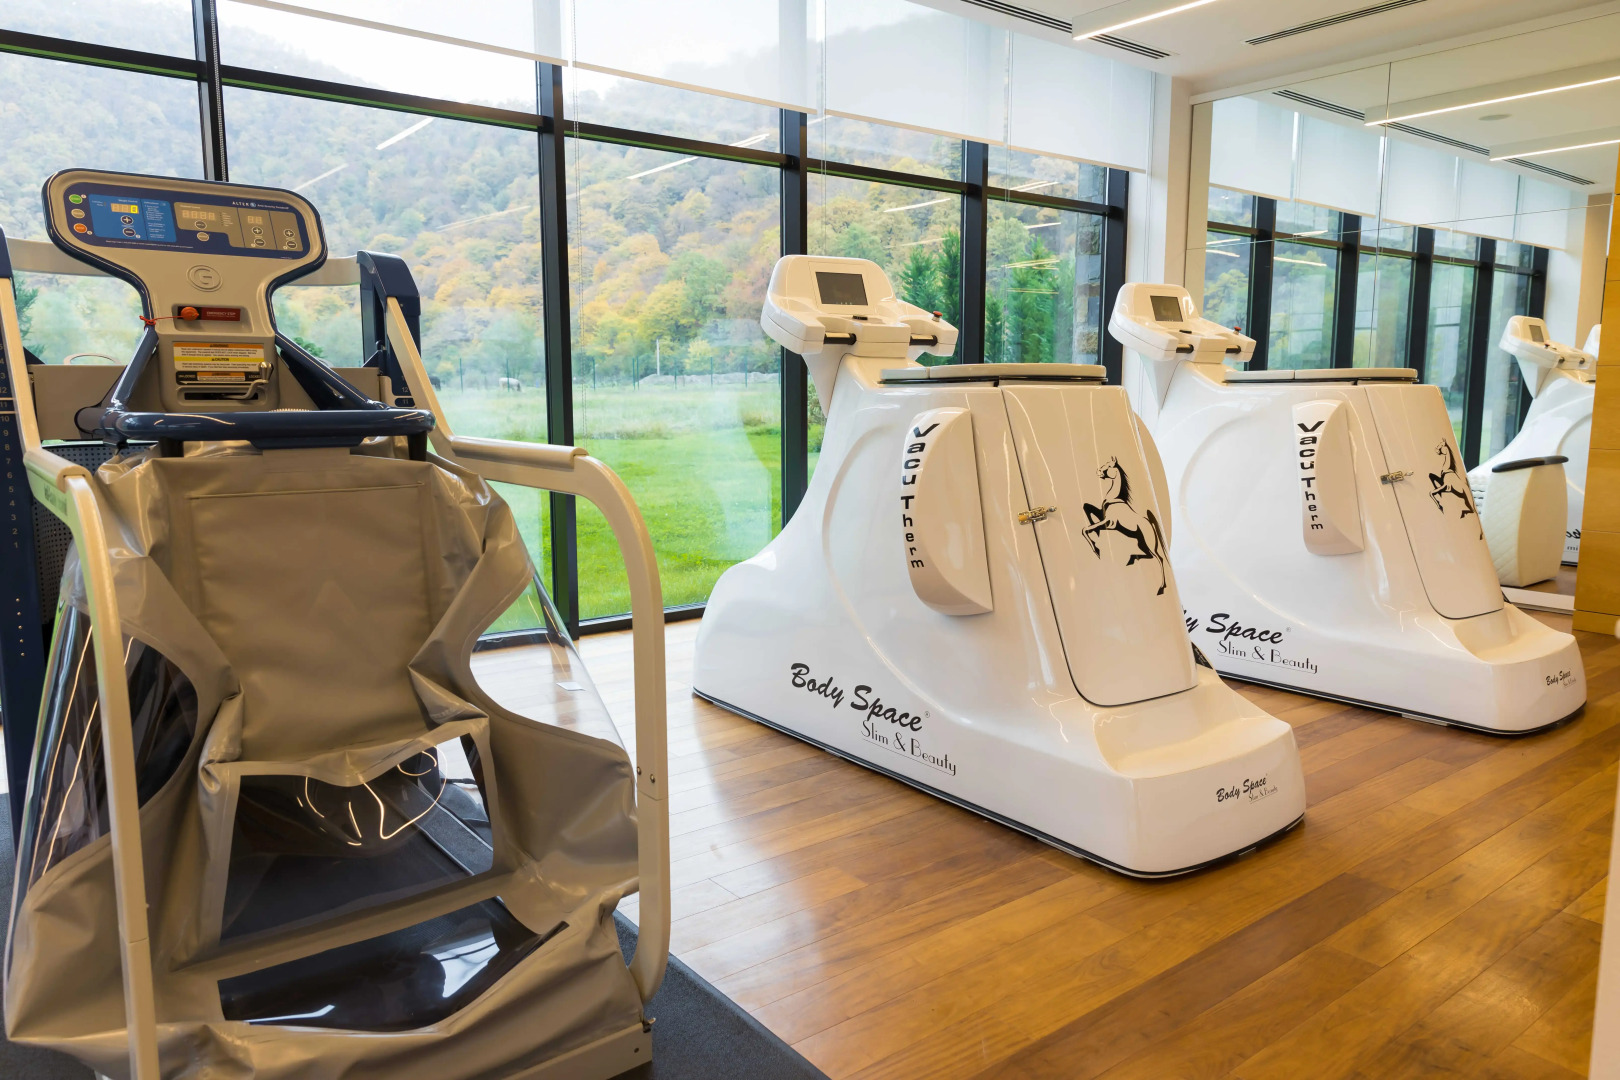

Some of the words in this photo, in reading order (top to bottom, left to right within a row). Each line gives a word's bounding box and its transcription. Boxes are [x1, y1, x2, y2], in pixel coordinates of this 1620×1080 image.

[1206, 613, 1283, 644] Space
[1217, 640, 1246, 657] Slim
[1251, 646, 1265, 661] &
[1271, 649, 1318, 674] Beauty
[791, 663, 844, 708] Body
[850, 685, 922, 731] Space
[861, 719, 888, 745] Slim
[893, 732, 906, 752] &
[911, 738, 956, 776] Beauty
[1216, 786, 1240, 802] Body
[1243, 777, 1266, 794] Space
